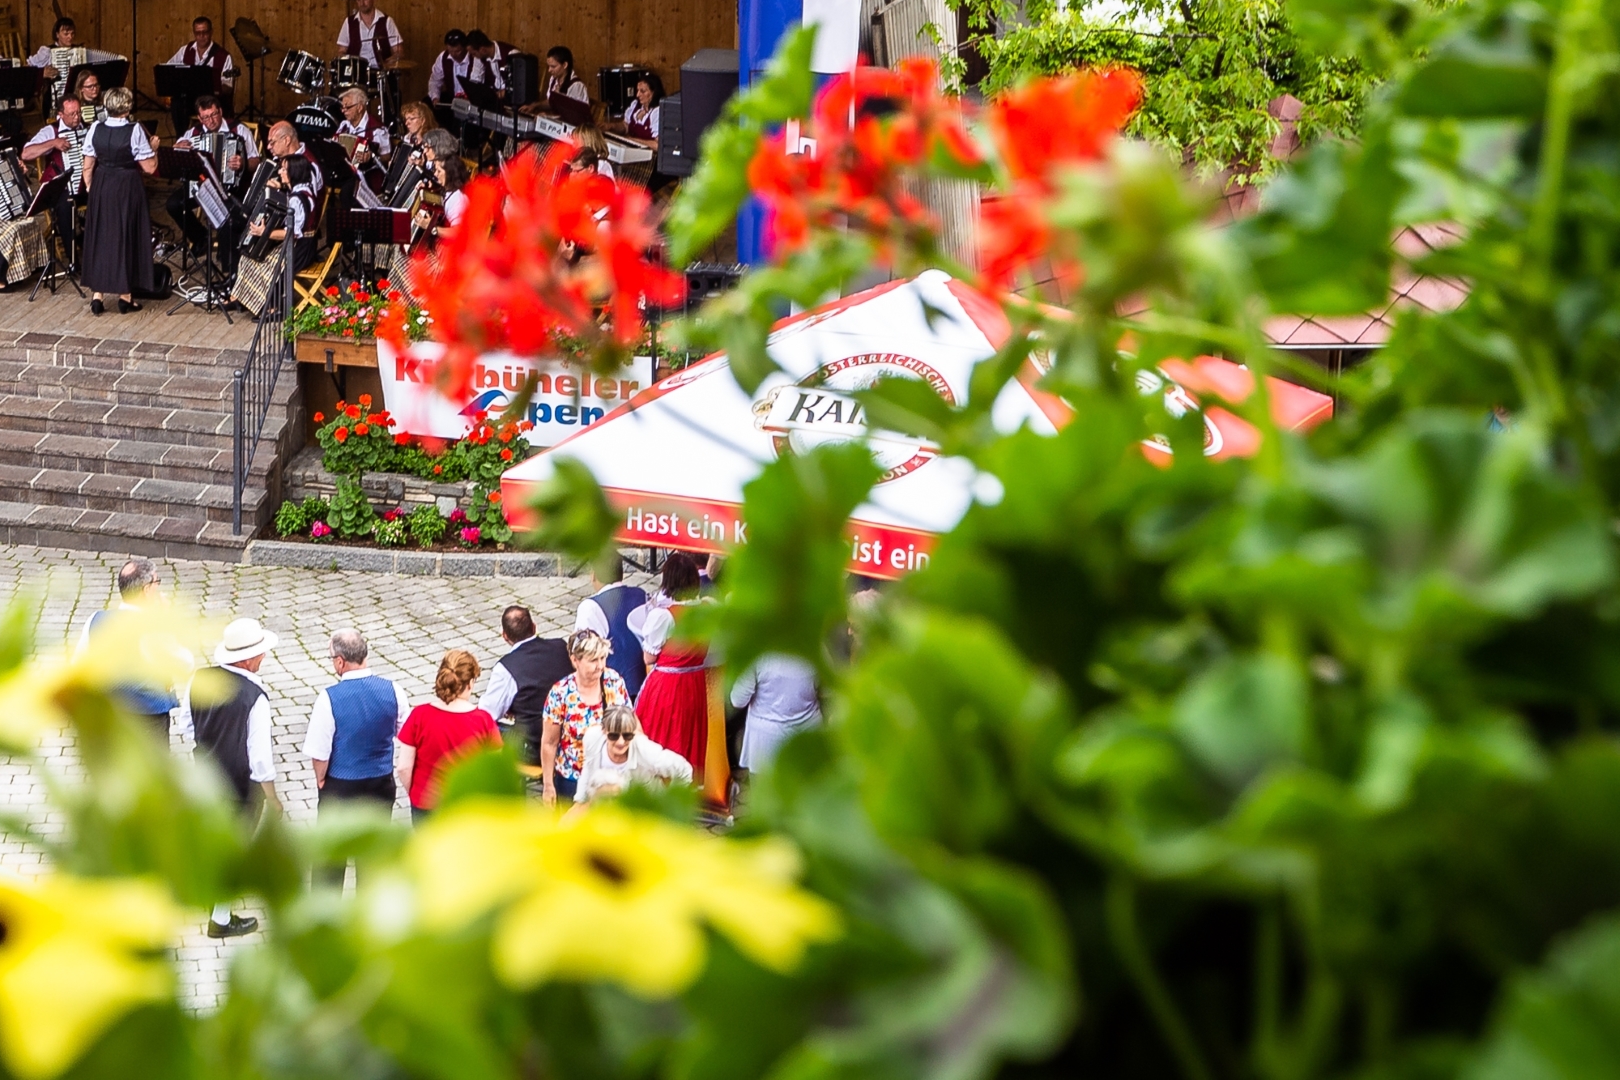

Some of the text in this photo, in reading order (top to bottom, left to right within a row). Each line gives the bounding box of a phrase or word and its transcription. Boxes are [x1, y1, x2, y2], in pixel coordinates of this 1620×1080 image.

[301, 114, 329, 128] TAMA
[627, 507, 679, 535] Hast
[687, 514, 725, 541] ein
[852, 535, 882, 565] ist
